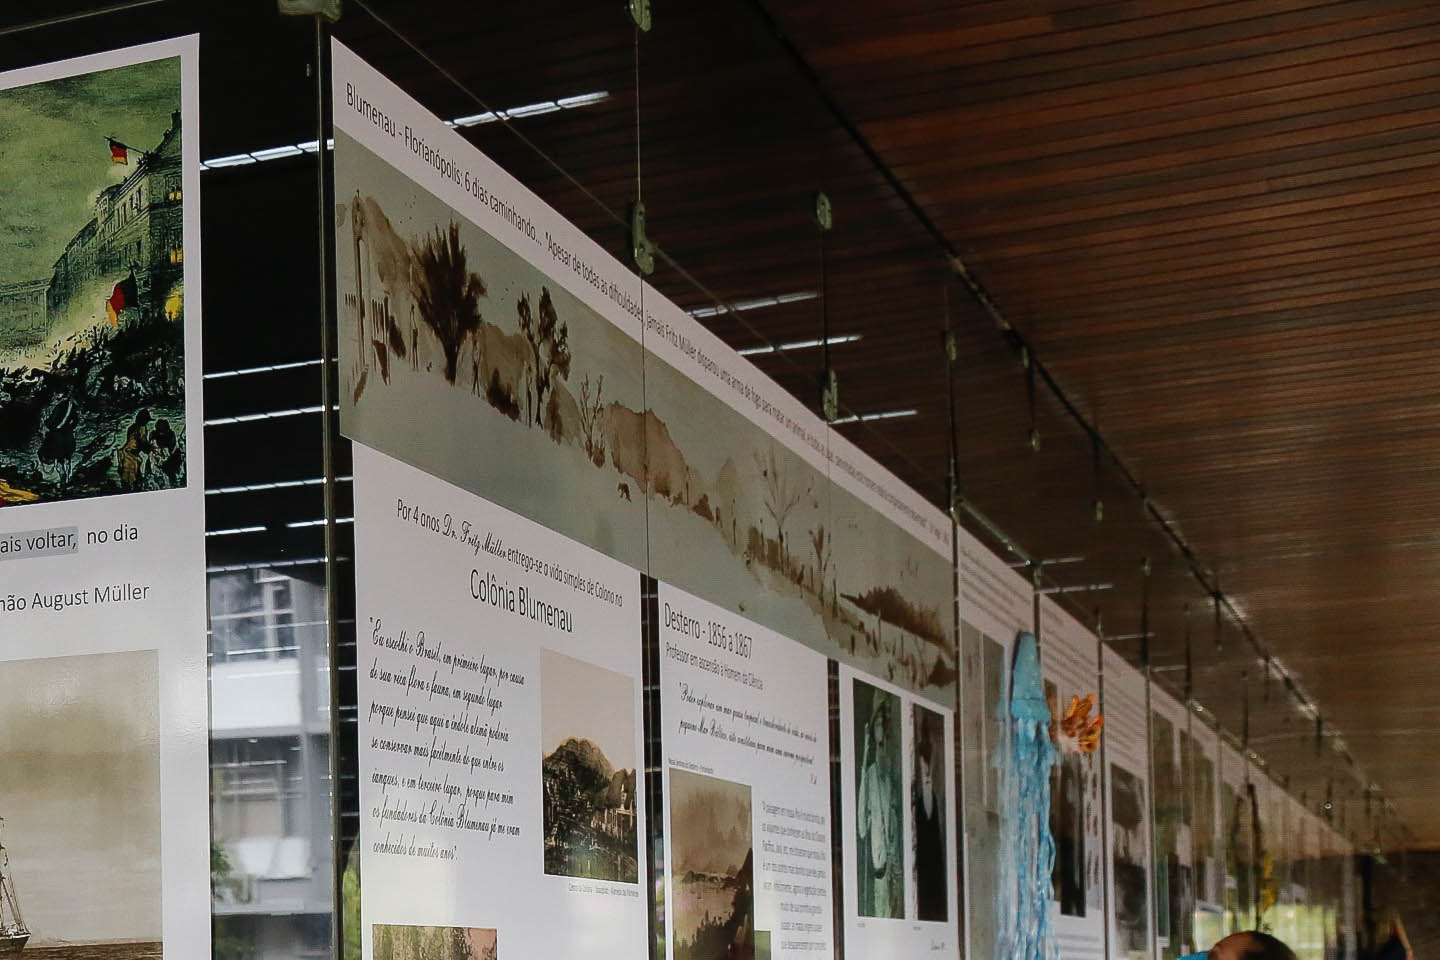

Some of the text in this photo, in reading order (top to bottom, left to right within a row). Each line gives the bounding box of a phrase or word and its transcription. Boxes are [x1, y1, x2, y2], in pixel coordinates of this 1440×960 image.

[346, 83, 396, 137] Blumenau
[464, 171, 470, 192] 6
[472, 178, 488, 205] dias
[573, 254, 580, 275] de
[582, 263, 600, 289] todas
[26, 532, 76, 550] voltar,
[88, 531, 108, 544] no
[114, 524, 137, 541] dia
[397, 499, 411, 521] Por
[413, 507, 418, 524] 4
[421, 514, 439, 533] anos
[443, 514, 457, 539] Dr.
[461, 521, 480, 555] Fritz
[482, 532, 506, 558] Müller
[564, 569, 585, 593] simples
[587, 578, 594, 594] de
[470, 569, 572, 632] Colônia Blumenau
[665, 603, 700, 639] Desterro
[708, 621, 727, 649] 1856
[728, 634, 733, 651] a
[735, 633, 752, 660] 1867
